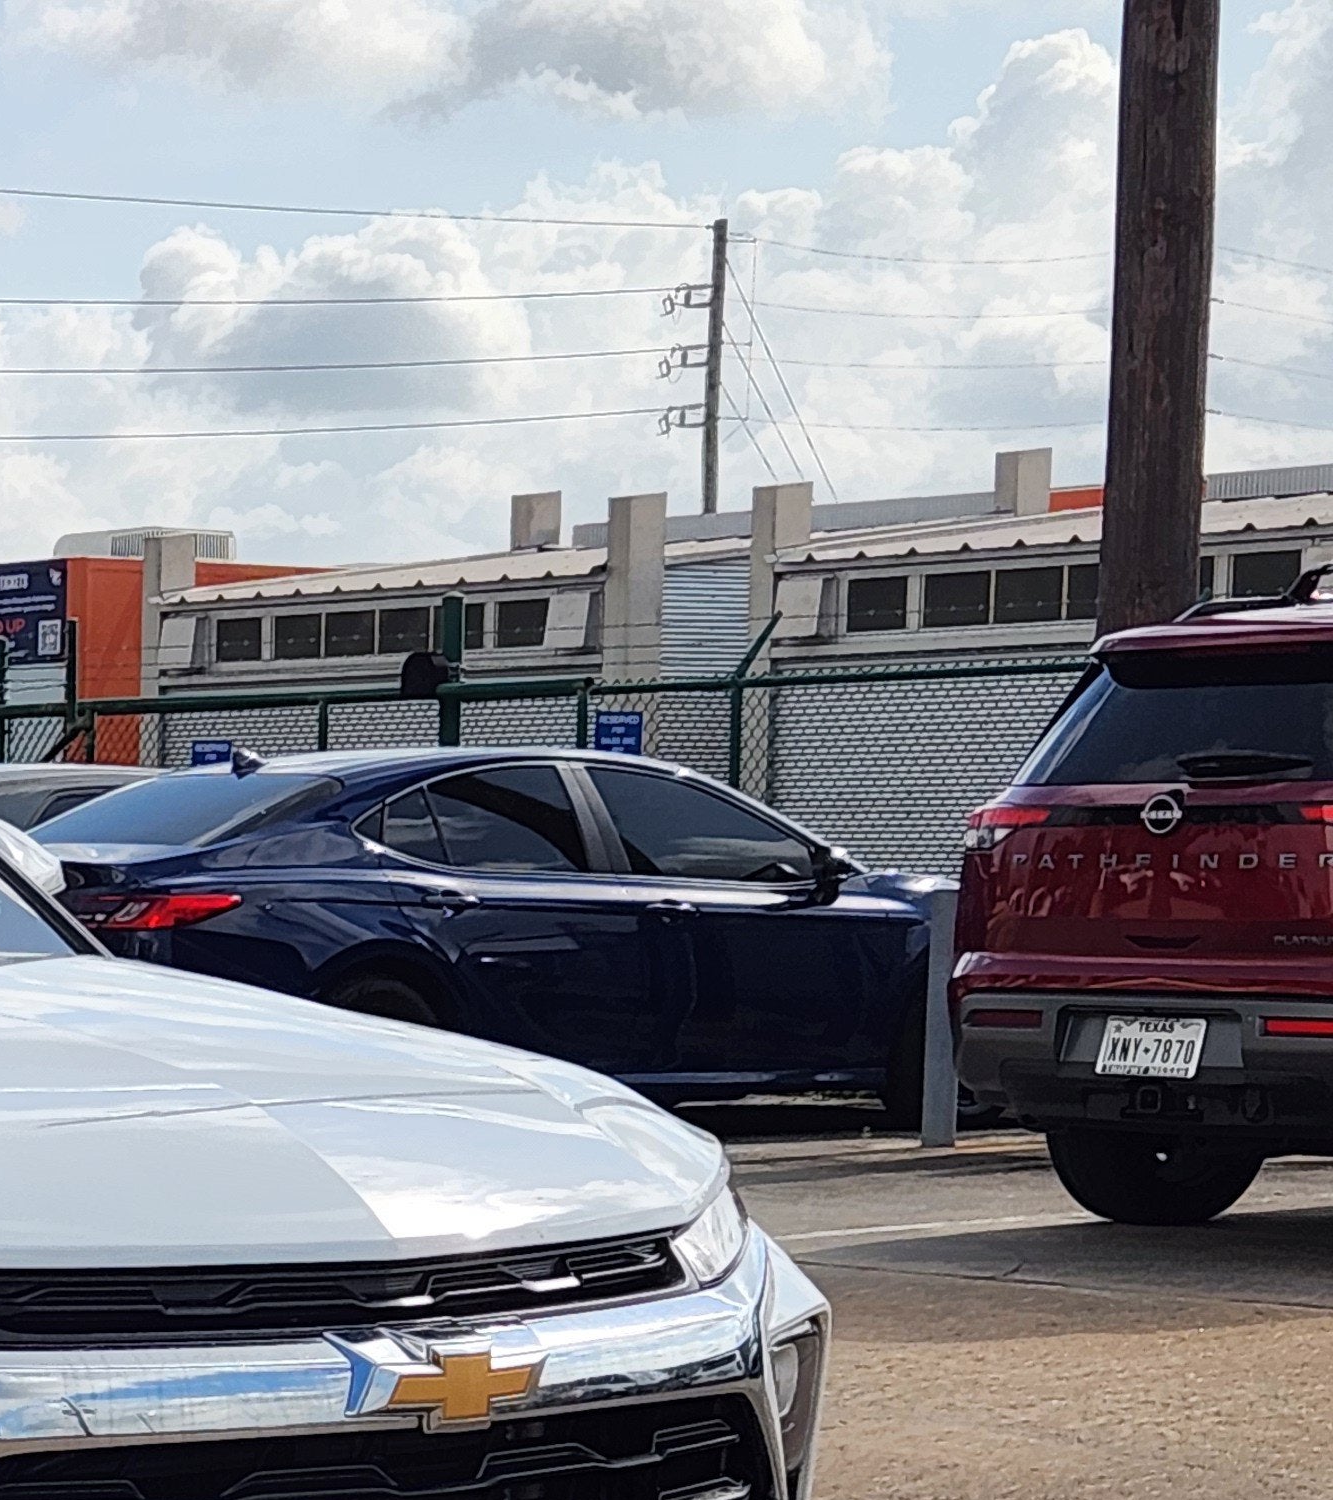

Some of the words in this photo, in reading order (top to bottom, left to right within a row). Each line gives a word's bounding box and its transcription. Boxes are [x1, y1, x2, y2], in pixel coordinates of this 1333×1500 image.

[6, 617, 26, 633] UP
[1013, 853, 1333, 870] PATHFINDER
[1139, 1021, 1175, 1034] TEXAS
